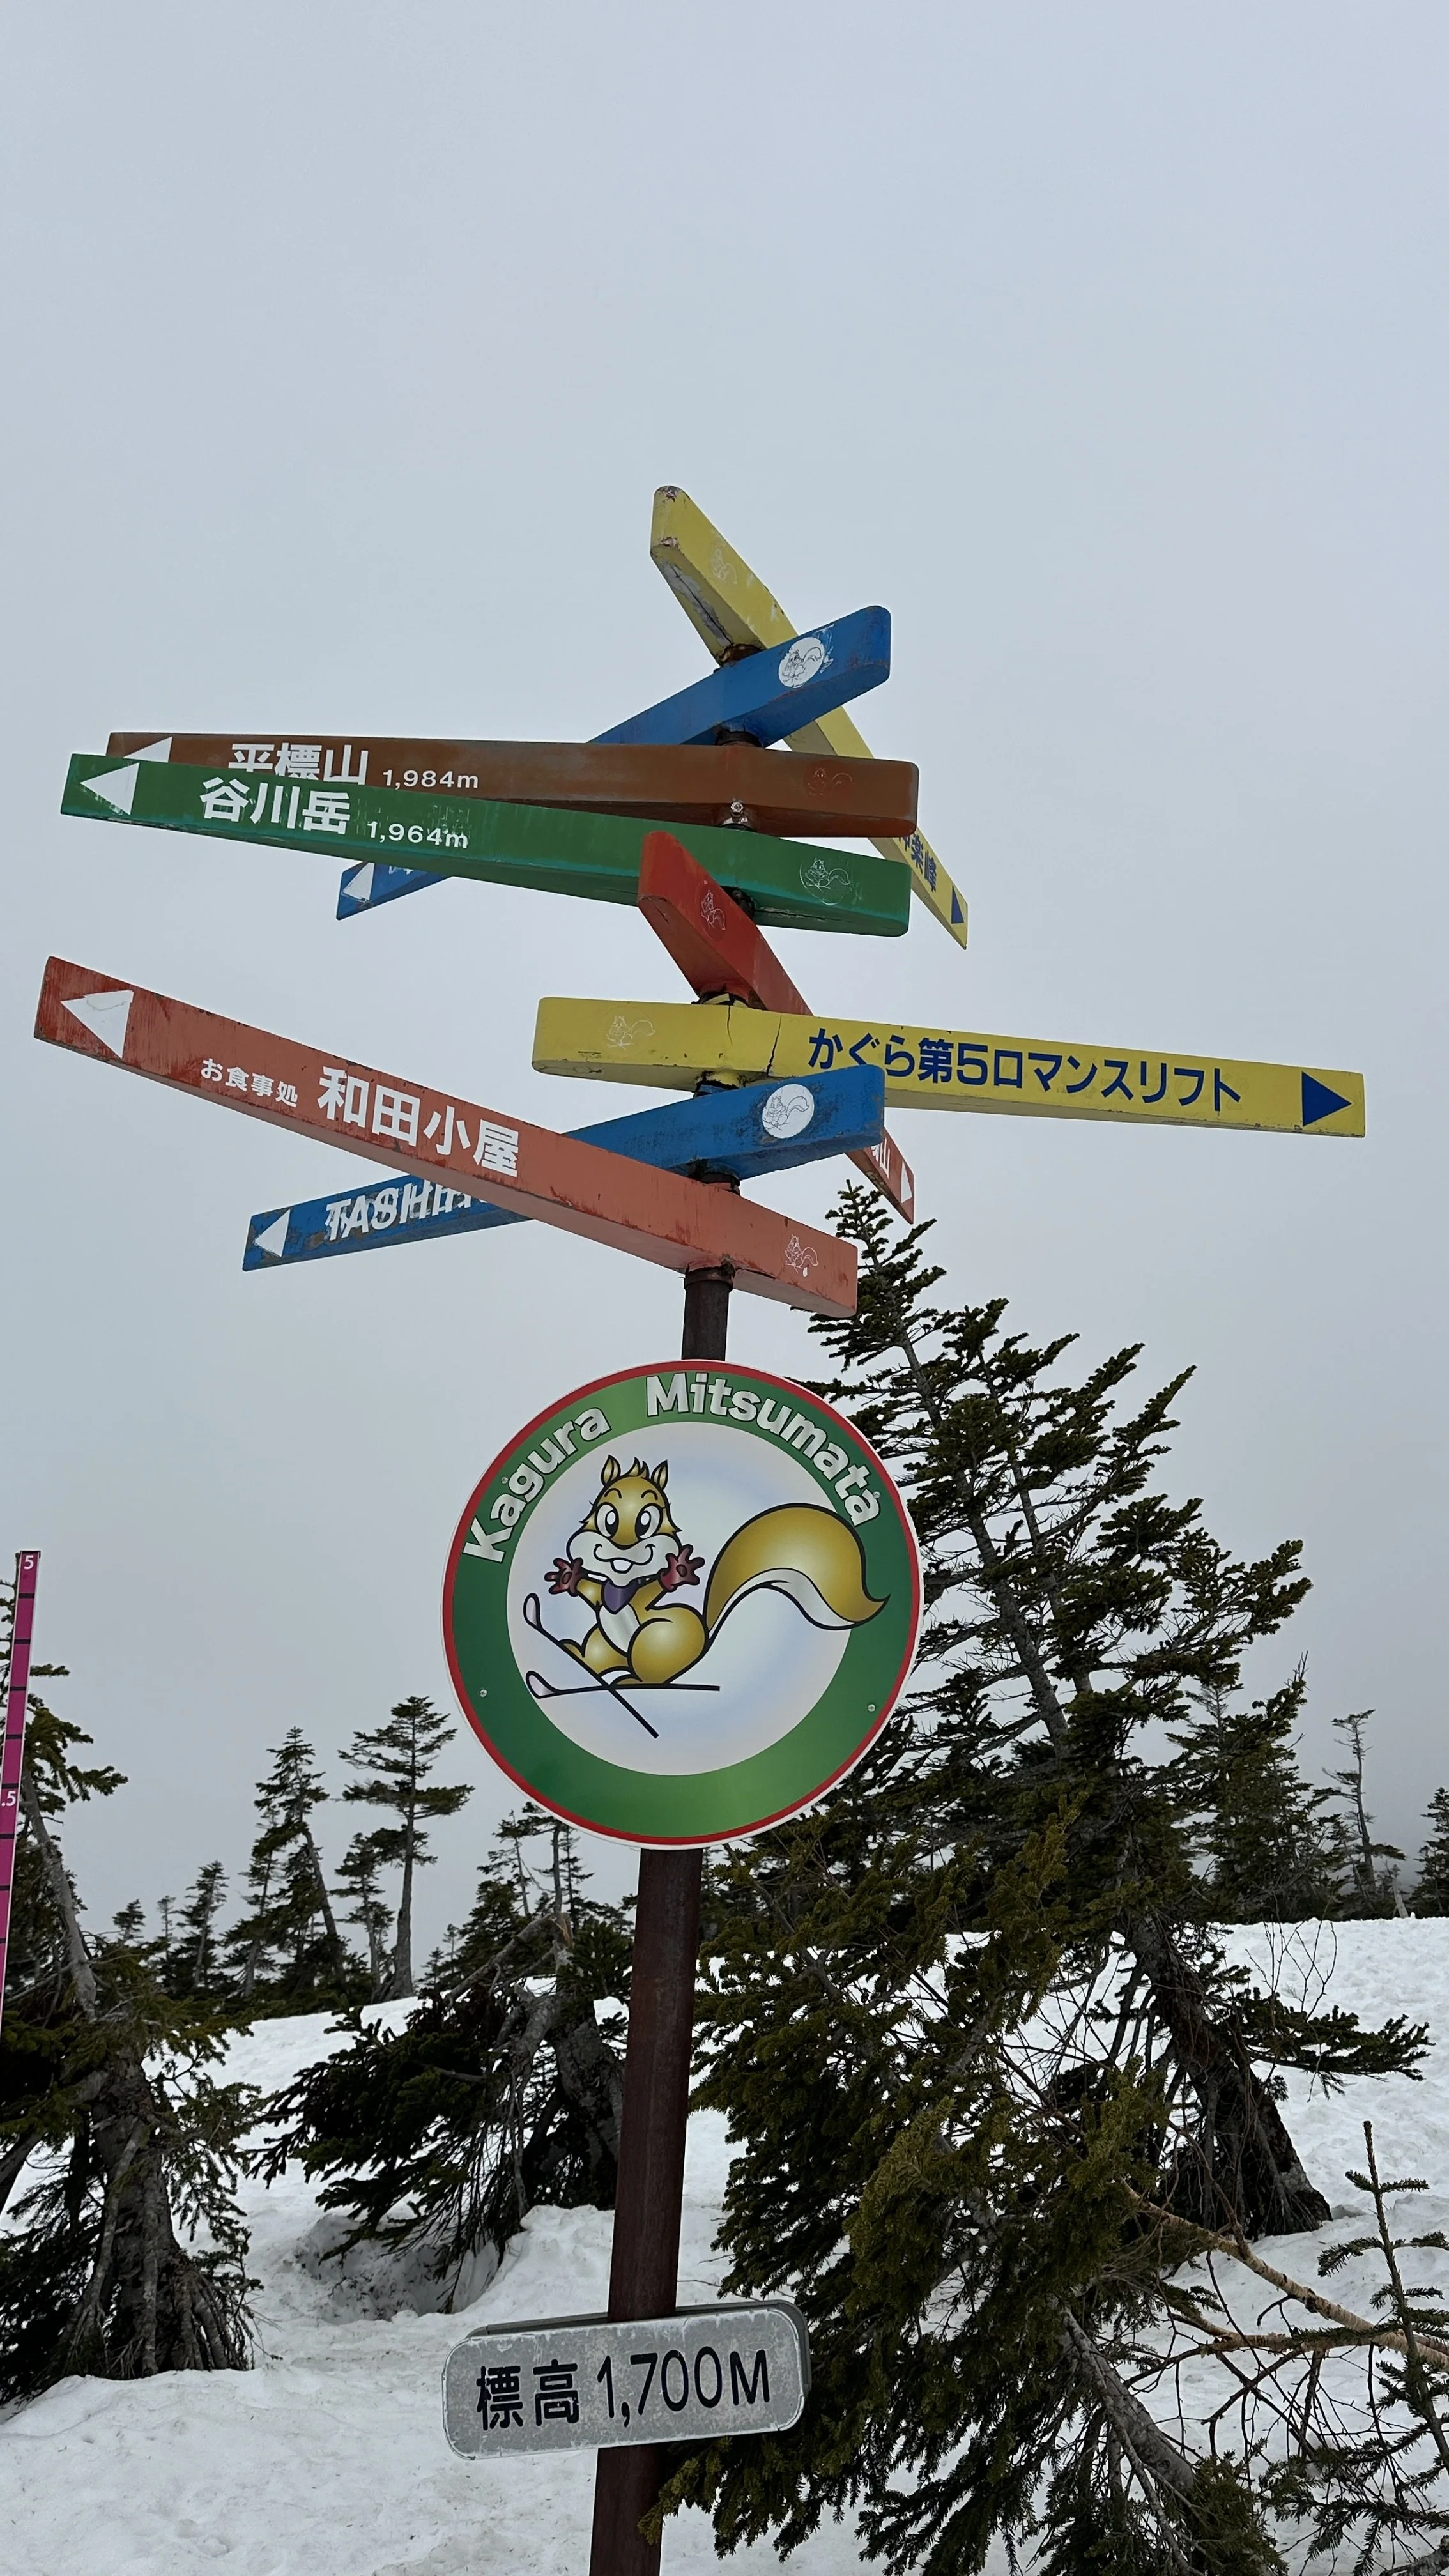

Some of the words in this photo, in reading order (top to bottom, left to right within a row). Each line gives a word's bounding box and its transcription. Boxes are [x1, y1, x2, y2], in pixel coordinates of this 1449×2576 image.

[228, 742, 369, 785] 平標山
[383, 769, 479, 790] 1,984m
[199, 776, 351, 835] 谷川岳
[367, 821, 468, 849] 1,964m
[808, 1027, 1241, 1112] かぐら第5ロマンスリフト
[201, 1058, 298, 1108] お食事処
[317, 1065, 519, 1178] 和田小屋
[463, 1406, 612, 1563] Kagura
[645, 1372, 881, 1526] Mitsumata
[24, 1554, 34, 1570] 5
[476, 2359, 579, 2430] 標高
[597, 2346, 770, 2427] 1,700M
